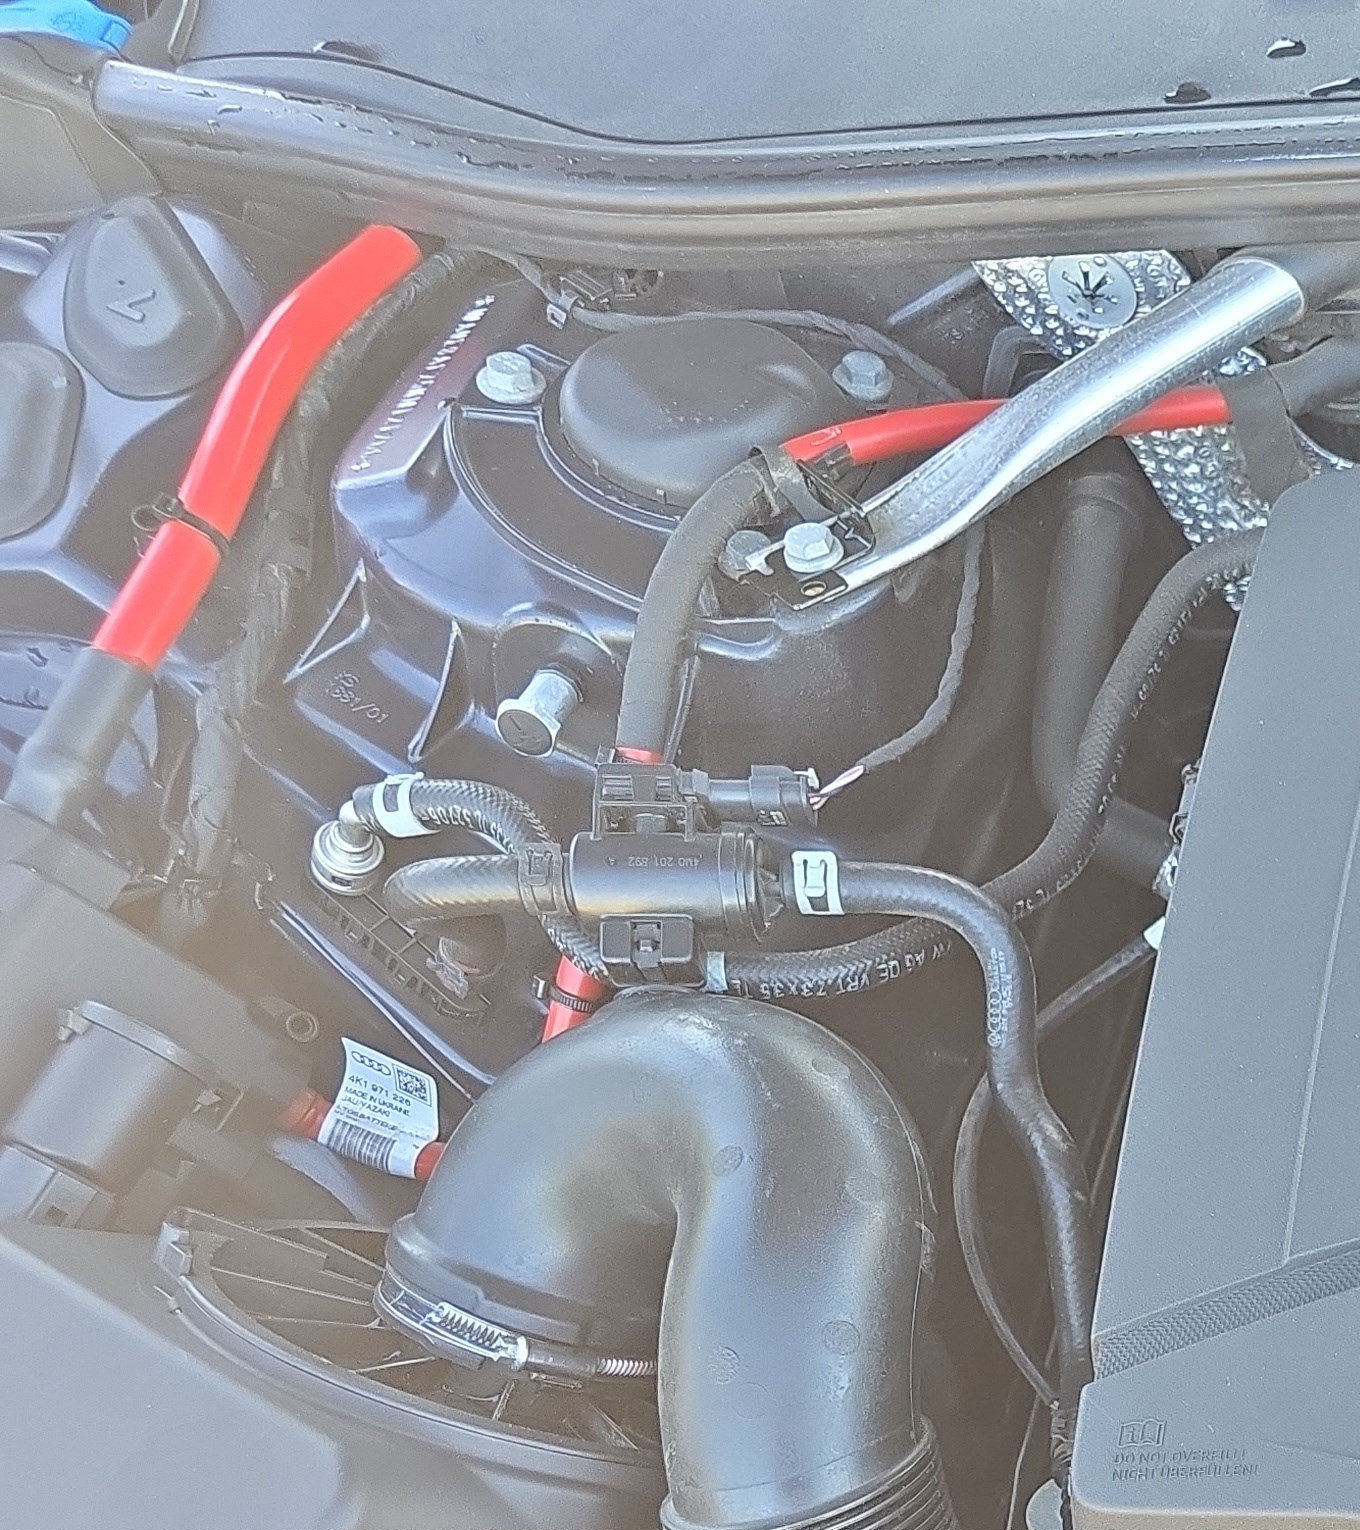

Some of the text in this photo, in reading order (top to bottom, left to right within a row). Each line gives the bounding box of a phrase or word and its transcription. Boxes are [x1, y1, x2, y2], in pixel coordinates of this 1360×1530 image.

[1113, 1447, 1247, 1465] DO NOT OVERFILL!
[1112, 1462, 1259, 1482] NICHT ÜBERFÜLLEN!
